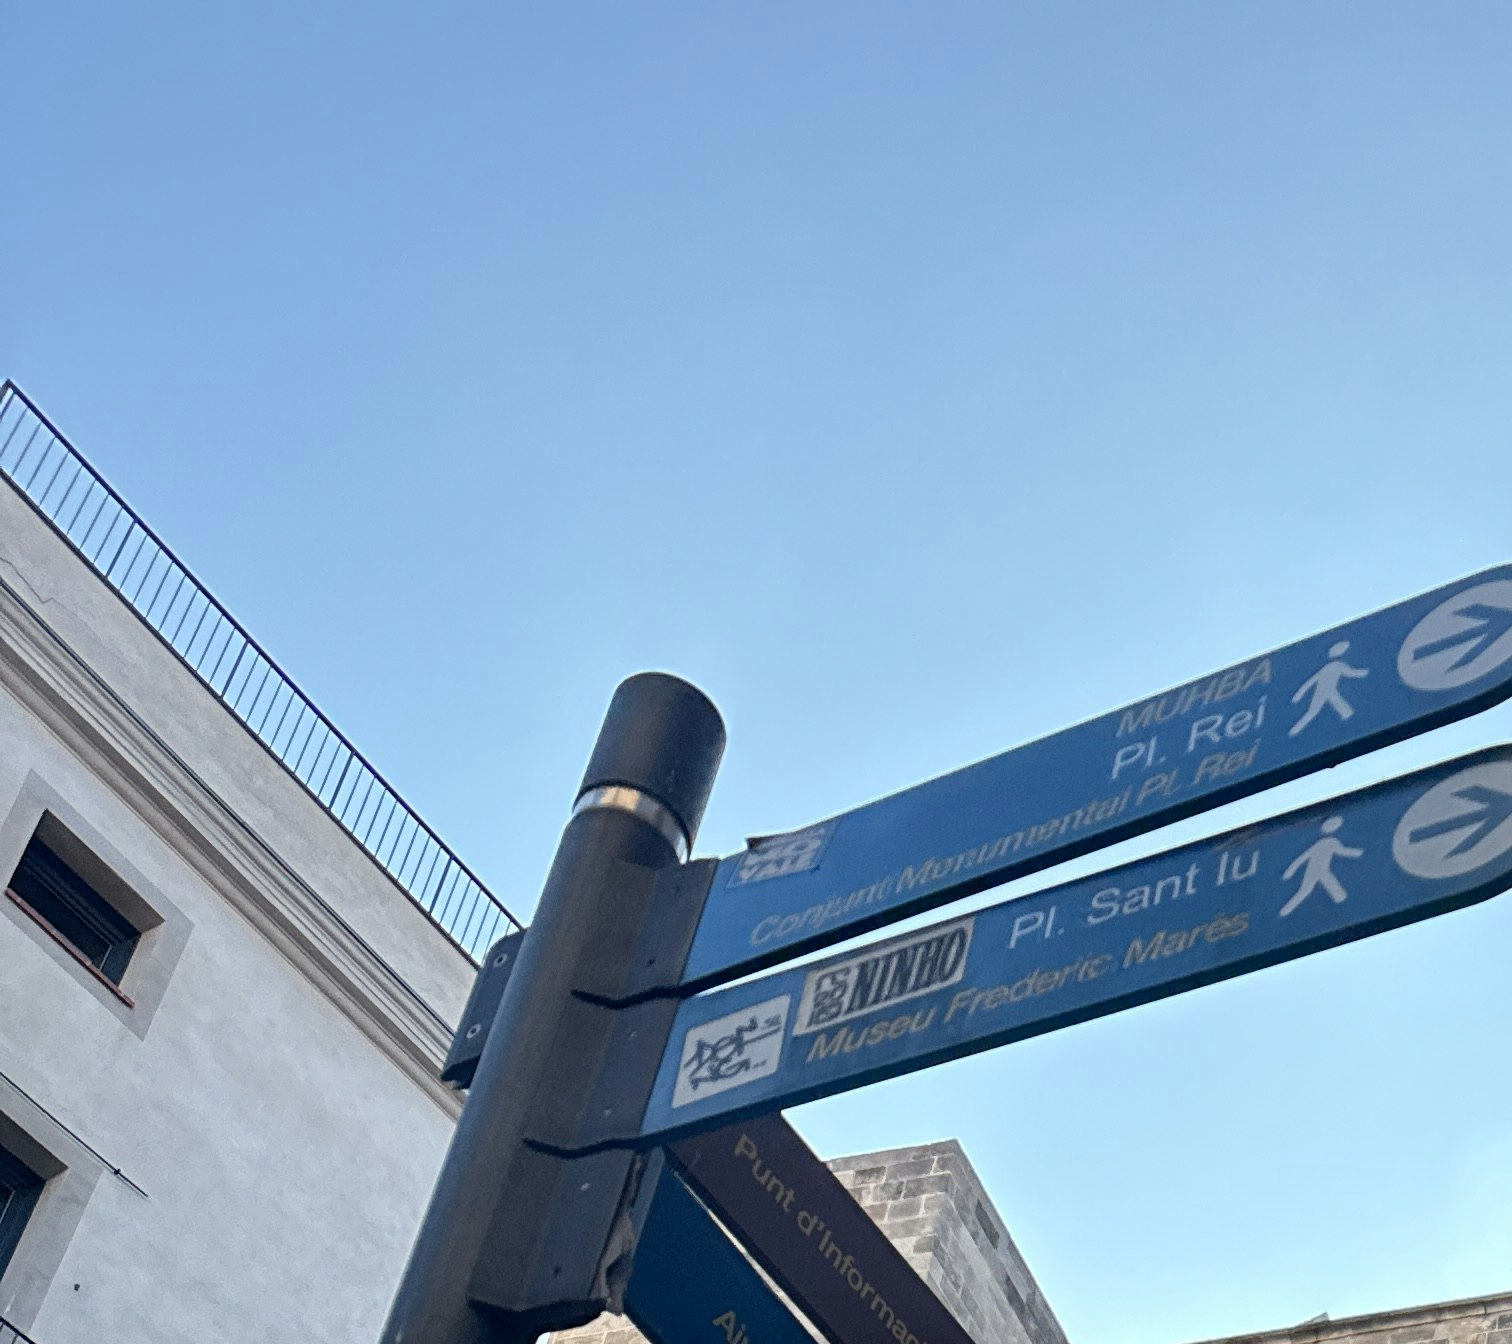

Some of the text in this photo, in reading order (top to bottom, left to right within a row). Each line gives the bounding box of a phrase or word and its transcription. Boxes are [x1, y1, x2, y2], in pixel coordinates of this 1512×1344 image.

[1111, 694, 1268, 780] Pl. Rei
[1115, 658, 1272, 739] MUHBA
[750, 877, 888, 946] Conjunt
[895, 785, 1132, 894] Monumental
[1192, 737, 1263, 786] Rei
[1007, 905, 1065, 949] Pl.
[1087, 862, 1201, 926] Sant
[804, 1005, 939, 1064] Museu
[944, 951, 1112, 1024] Frederic
[844, 927, 968, 1016] NINHO
[733, 1133, 797, 1213] Punt
